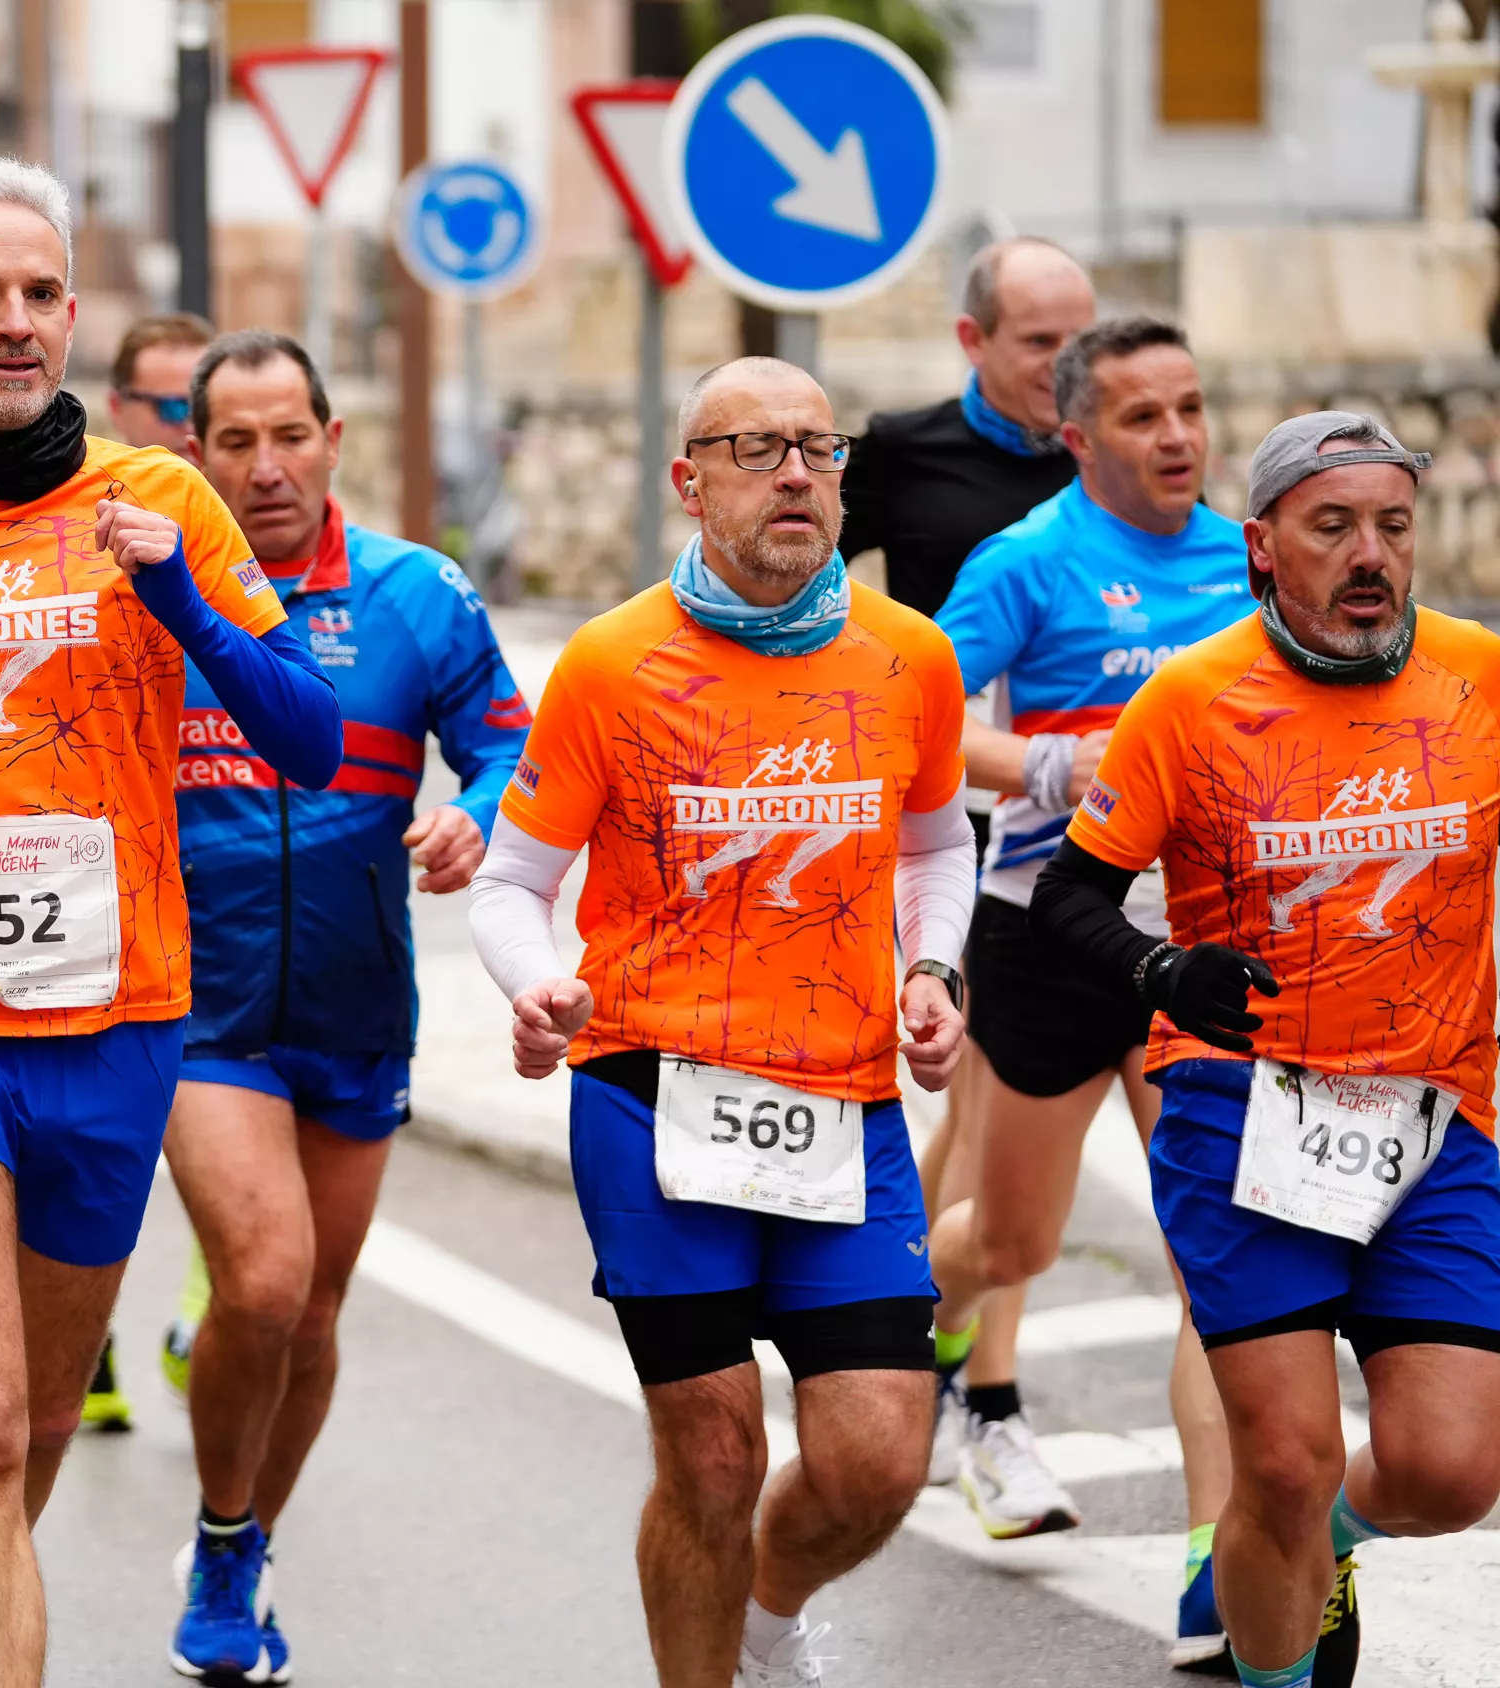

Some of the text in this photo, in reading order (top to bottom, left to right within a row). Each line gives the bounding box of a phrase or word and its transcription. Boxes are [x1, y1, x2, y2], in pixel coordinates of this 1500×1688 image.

[178, 713, 247, 746] rató
[174, 755, 255, 787] cena
[671, 785, 883, 827] DATACONES
[1251, 807, 1469, 862] DATACONES
[711, 1094, 816, 1154] 569
[1336, 1091, 1396, 1119] LUCENA
[1298, 1122, 1405, 1186] 498
